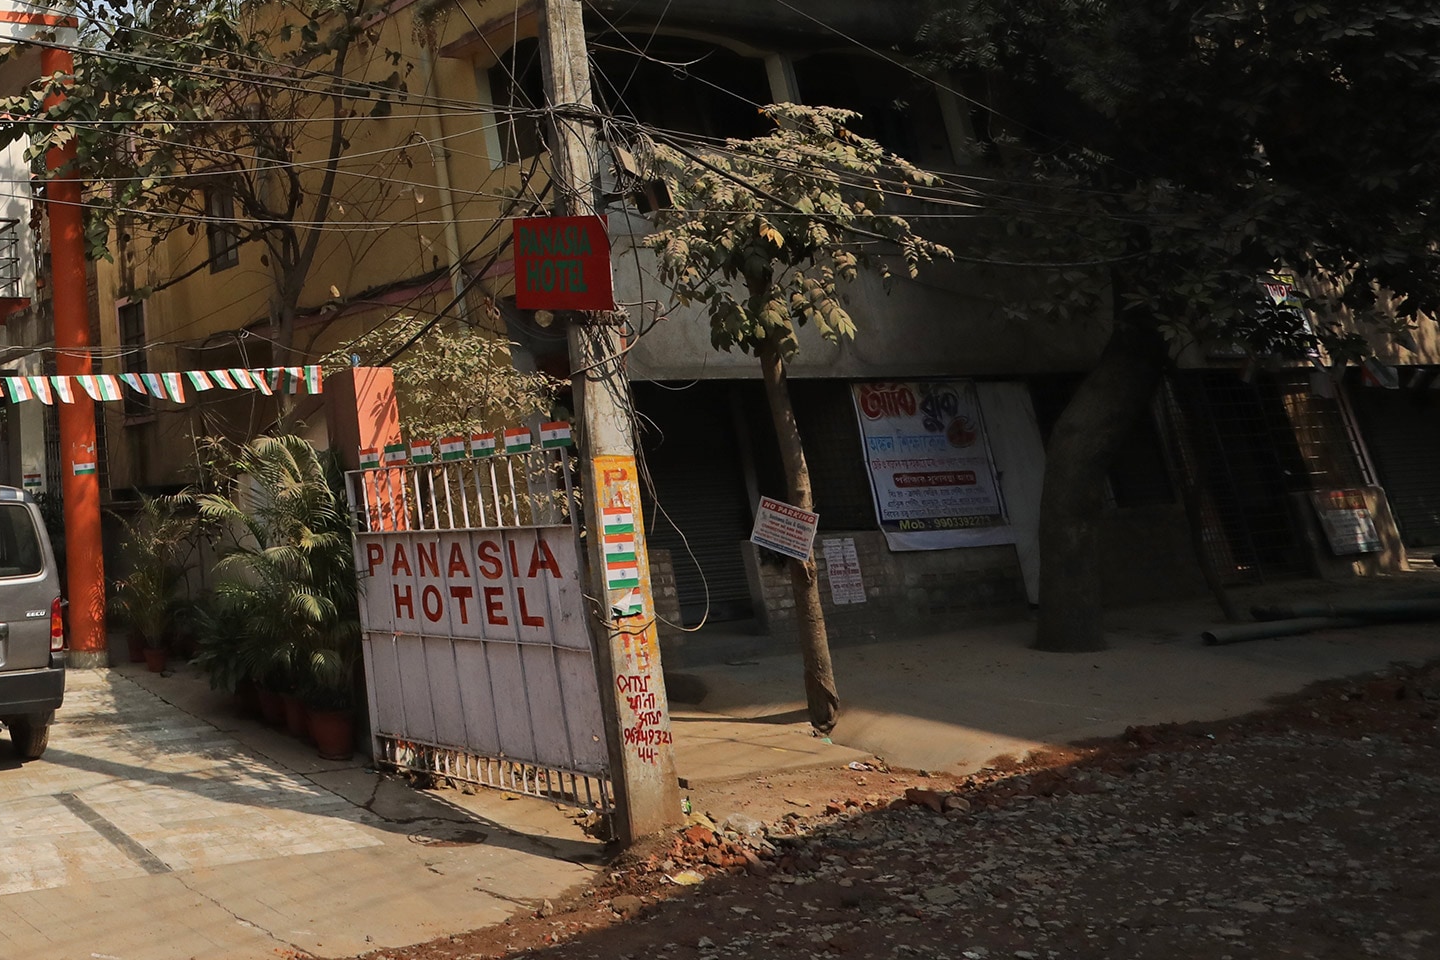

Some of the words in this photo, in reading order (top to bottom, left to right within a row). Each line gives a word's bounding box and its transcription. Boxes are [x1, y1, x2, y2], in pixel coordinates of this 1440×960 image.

[520, 226, 592, 256] PANASIA
[526, 259, 588, 292] HOTEL
[763, 501, 776, 510] NO
[777, 505, 815, 522] PARKING
[899, 520, 926, 530] Mob
[366, 538, 563, 580] PANASIA
[393, 584, 545, 627] HOTEL
